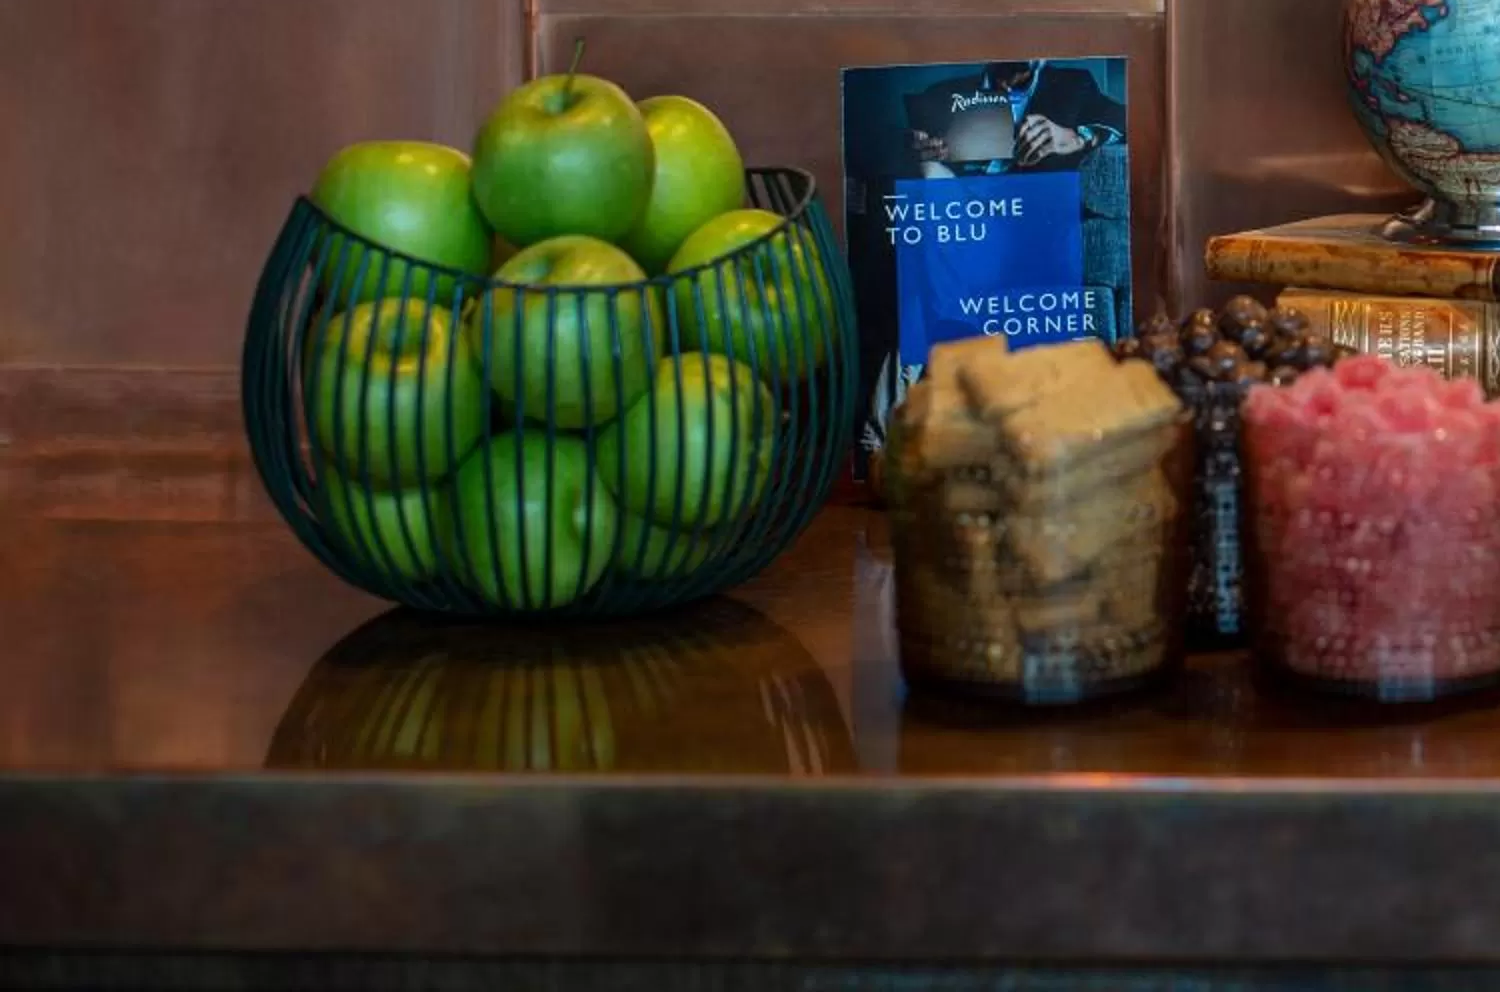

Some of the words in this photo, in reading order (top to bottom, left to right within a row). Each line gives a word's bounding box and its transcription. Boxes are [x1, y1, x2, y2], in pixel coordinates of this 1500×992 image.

[884, 198, 1024, 222] WELCOME
[885, 226, 922, 245] TO
[937, 223, 987, 243] BLU
[959, 291, 1096, 315] WELCOME
[983, 314, 1097, 337] CORNER
